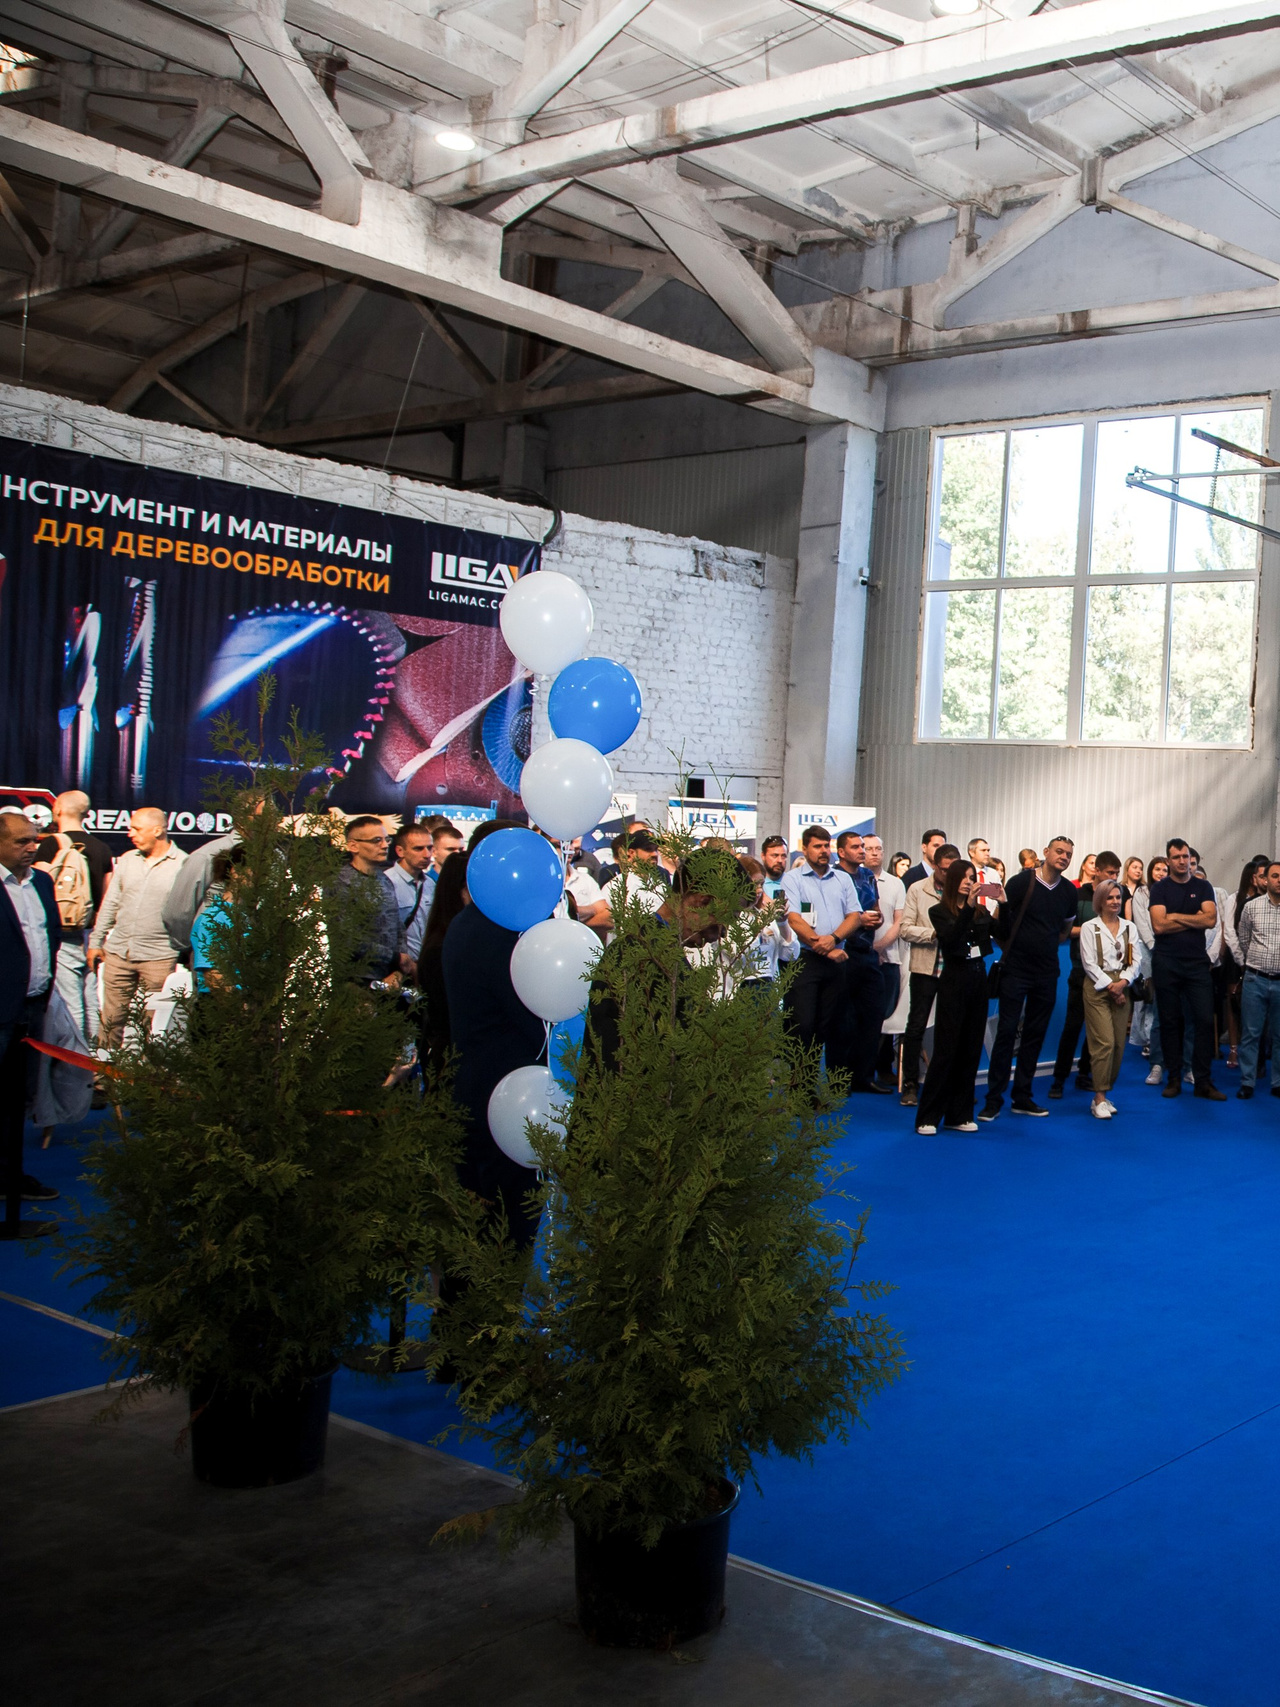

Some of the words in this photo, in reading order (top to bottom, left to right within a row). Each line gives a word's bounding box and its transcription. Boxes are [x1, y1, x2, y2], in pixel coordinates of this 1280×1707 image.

[0, 474, 195, 529] НСТРУМЕНТ
[201, 511, 221, 535] И
[227, 515, 392, 564] МАТЕРИАЛЫ
[33, 518, 105, 550] ДЛЯ
[111, 531, 390, 595] ДЕРЕВООБРАБОТКИ
[82, 809, 233, 834] REAOOD
[798, 814, 837, 827] LIGA
